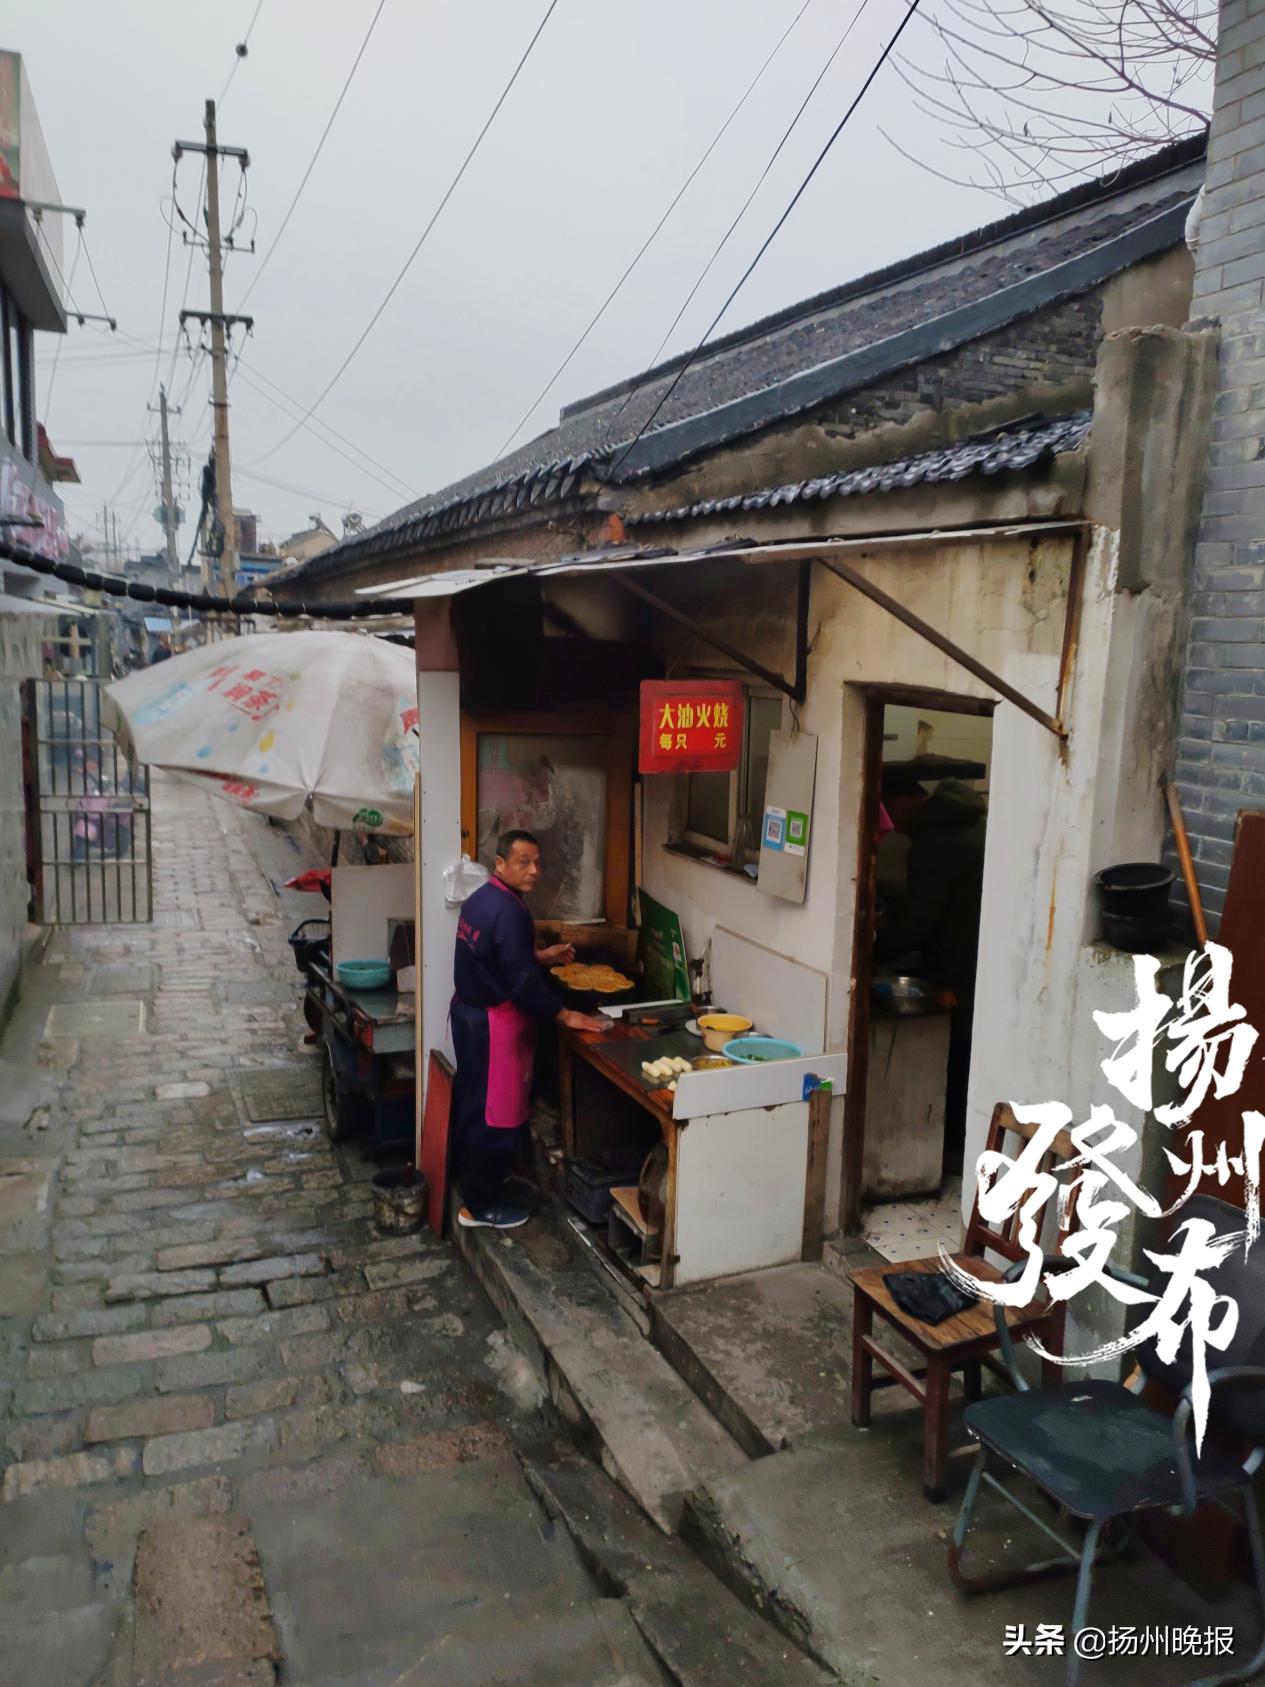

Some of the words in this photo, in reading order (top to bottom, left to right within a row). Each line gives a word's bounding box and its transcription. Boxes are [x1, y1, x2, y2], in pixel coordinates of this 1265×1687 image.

[659, 703, 729, 729] 大油火烧
[659, 732, 687, 750] 每只
[714, 732, 727, 749] 元
